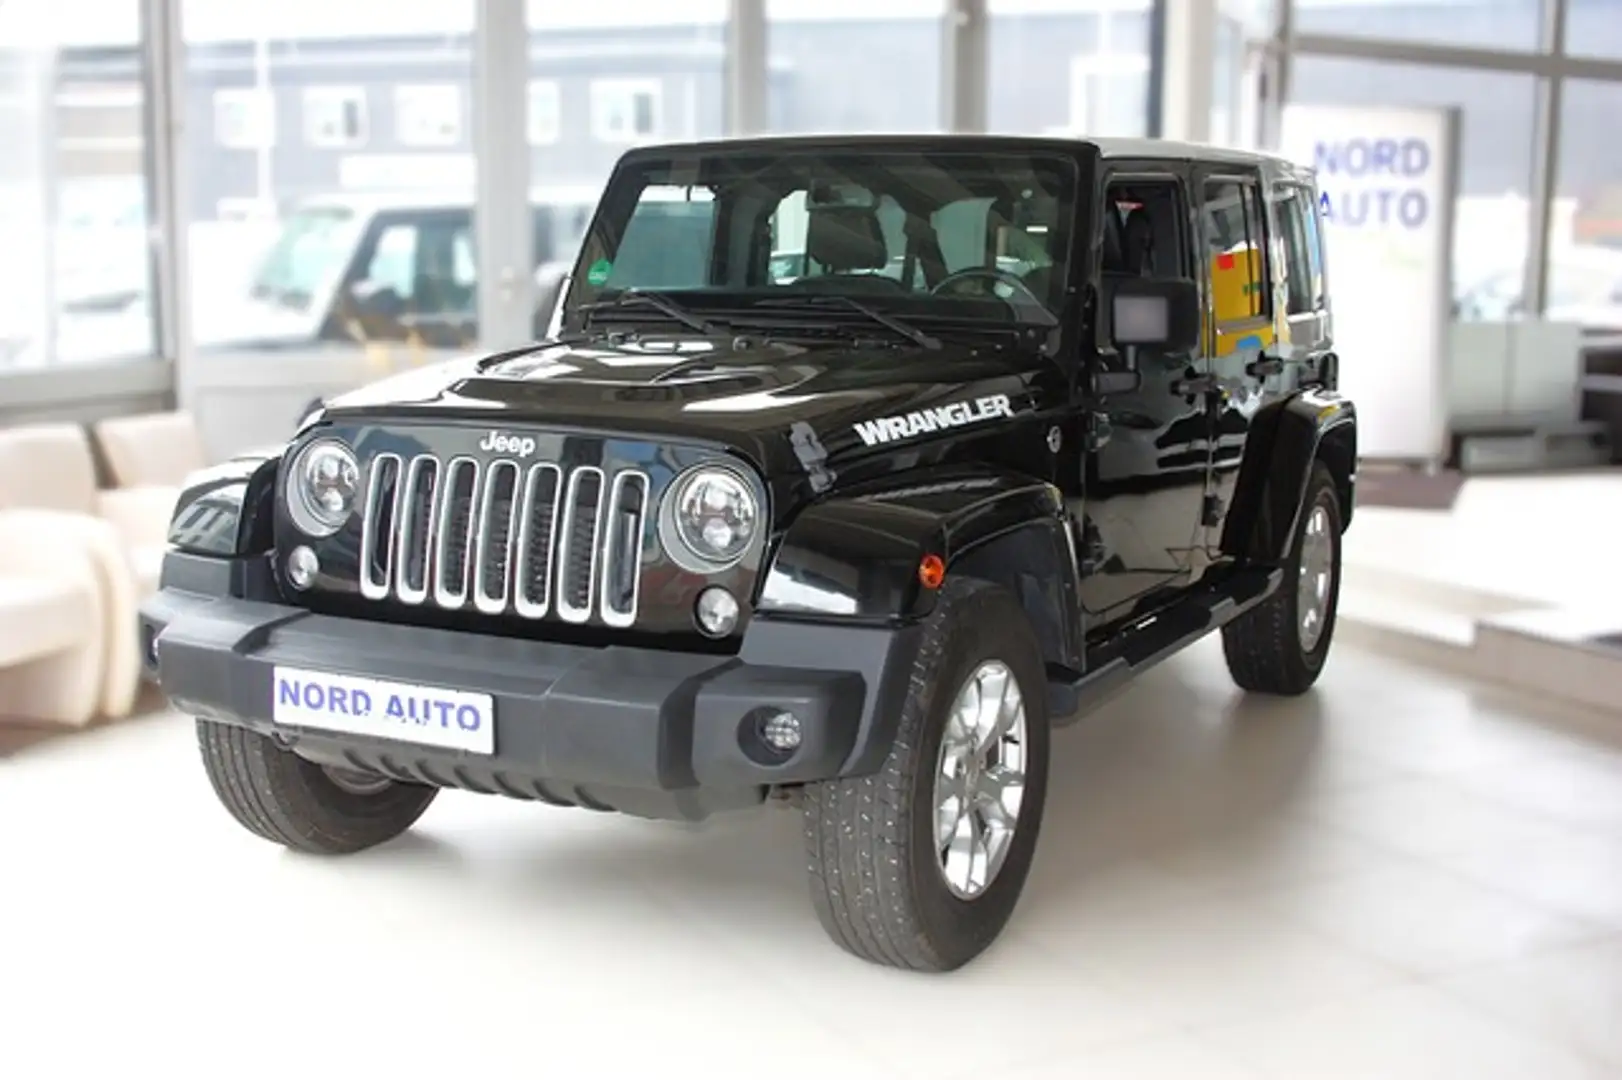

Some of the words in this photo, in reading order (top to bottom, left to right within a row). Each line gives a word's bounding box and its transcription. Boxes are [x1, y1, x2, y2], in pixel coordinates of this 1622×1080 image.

[1315, 138, 1429, 176] NORD
[1317, 190, 1428, 229] AUTO
[853, 394, 1016, 446] WRANGLER
[480, 430, 535, 457] Jeep
[280, 679, 371, 715] NORD
[386, 694, 481, 731] AUTO
